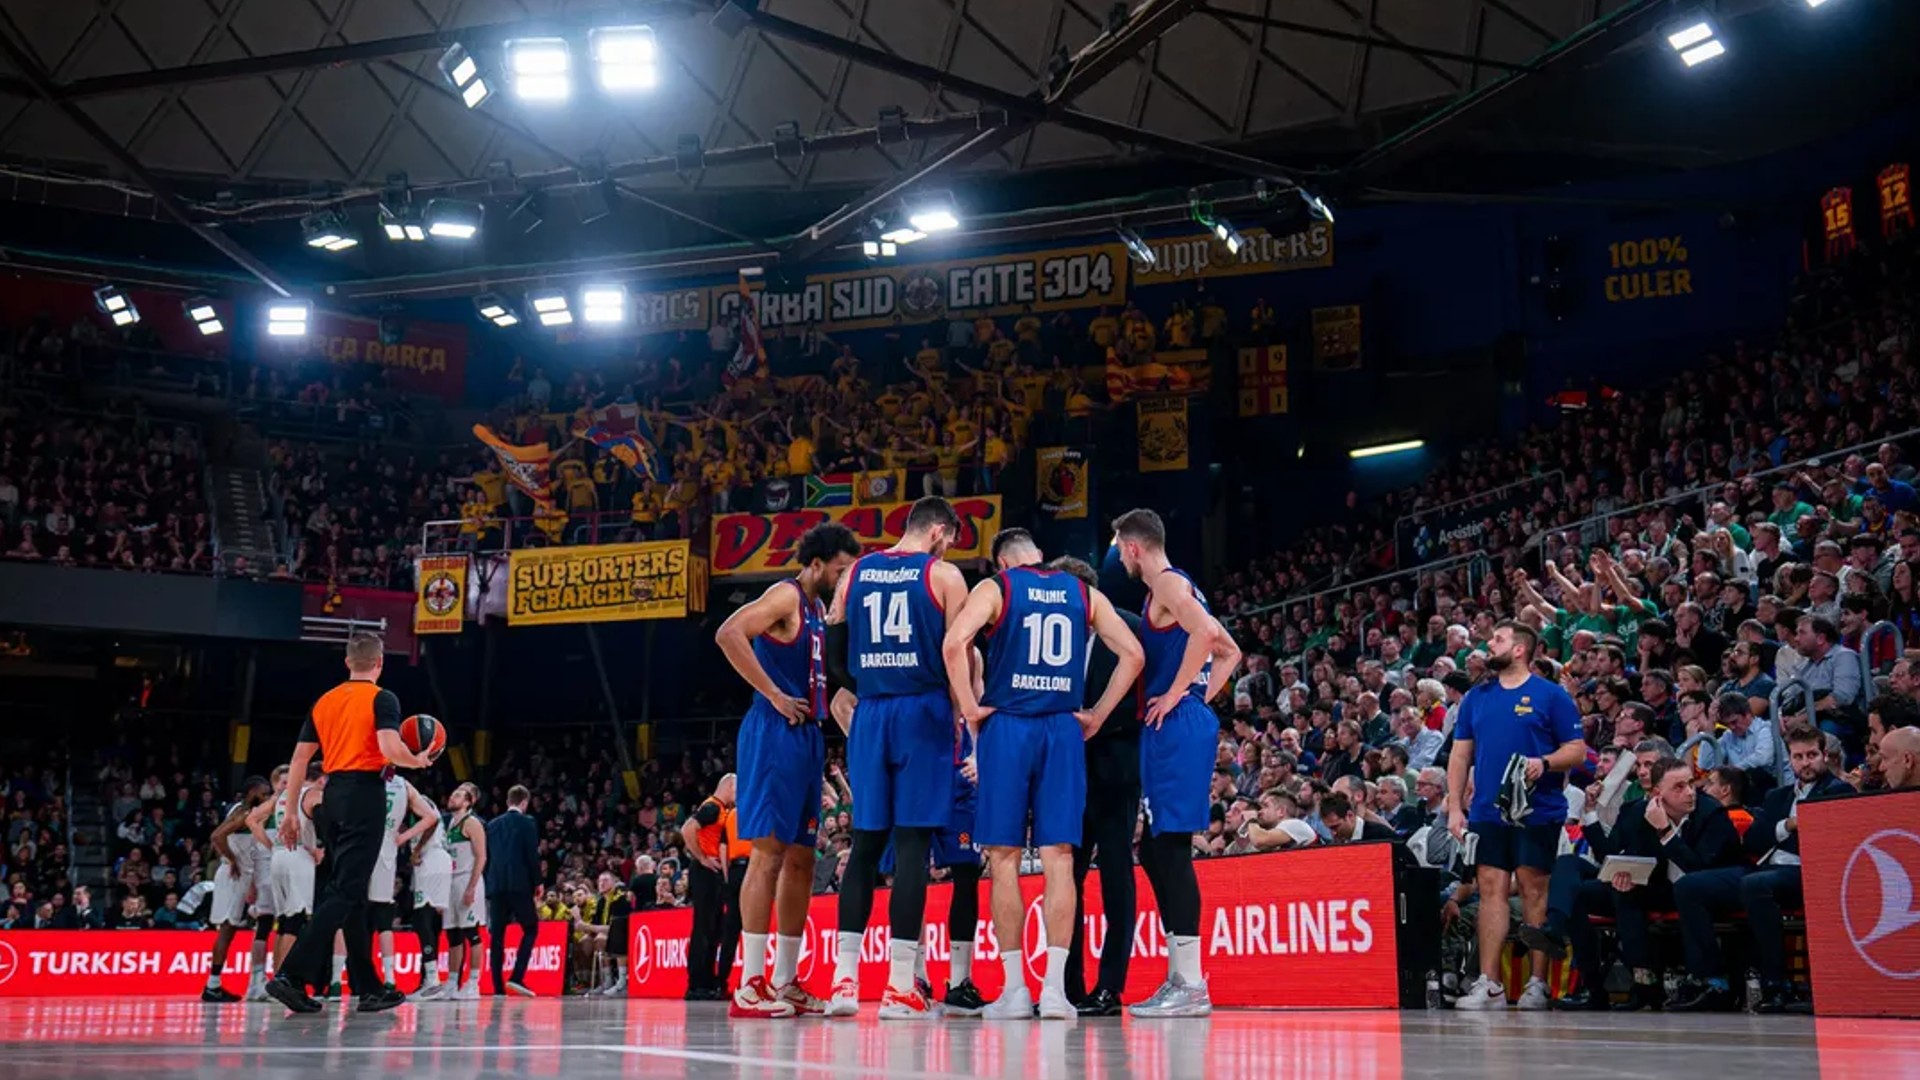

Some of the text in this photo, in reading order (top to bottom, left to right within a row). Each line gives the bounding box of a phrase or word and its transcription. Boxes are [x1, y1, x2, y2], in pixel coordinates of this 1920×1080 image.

[1881, 182, 1906, 210] 12
[1825, 203, 1849, 231] 15
[1608, 234, 1688, 268] 100%
[719, 253, 1113, 327] CRBA SUD GATE 304
[1604, 269, 1693, 302] CULER
[624, 291, 699, 326] RACS
[515, 547, 684, 591] SUPPORTERS
[863, 591, 912, 643] 14
[1023, 613, 1073, 667] 10
[860, 652, 919, 668] BARCELONA
[1012, 673, 1071, 692] BARCELONA
[1209, 898, 1373, 956] AIRLINES
[29, 952, 161, 975] TURKISH
[655, 938, 689, 968] TURK
